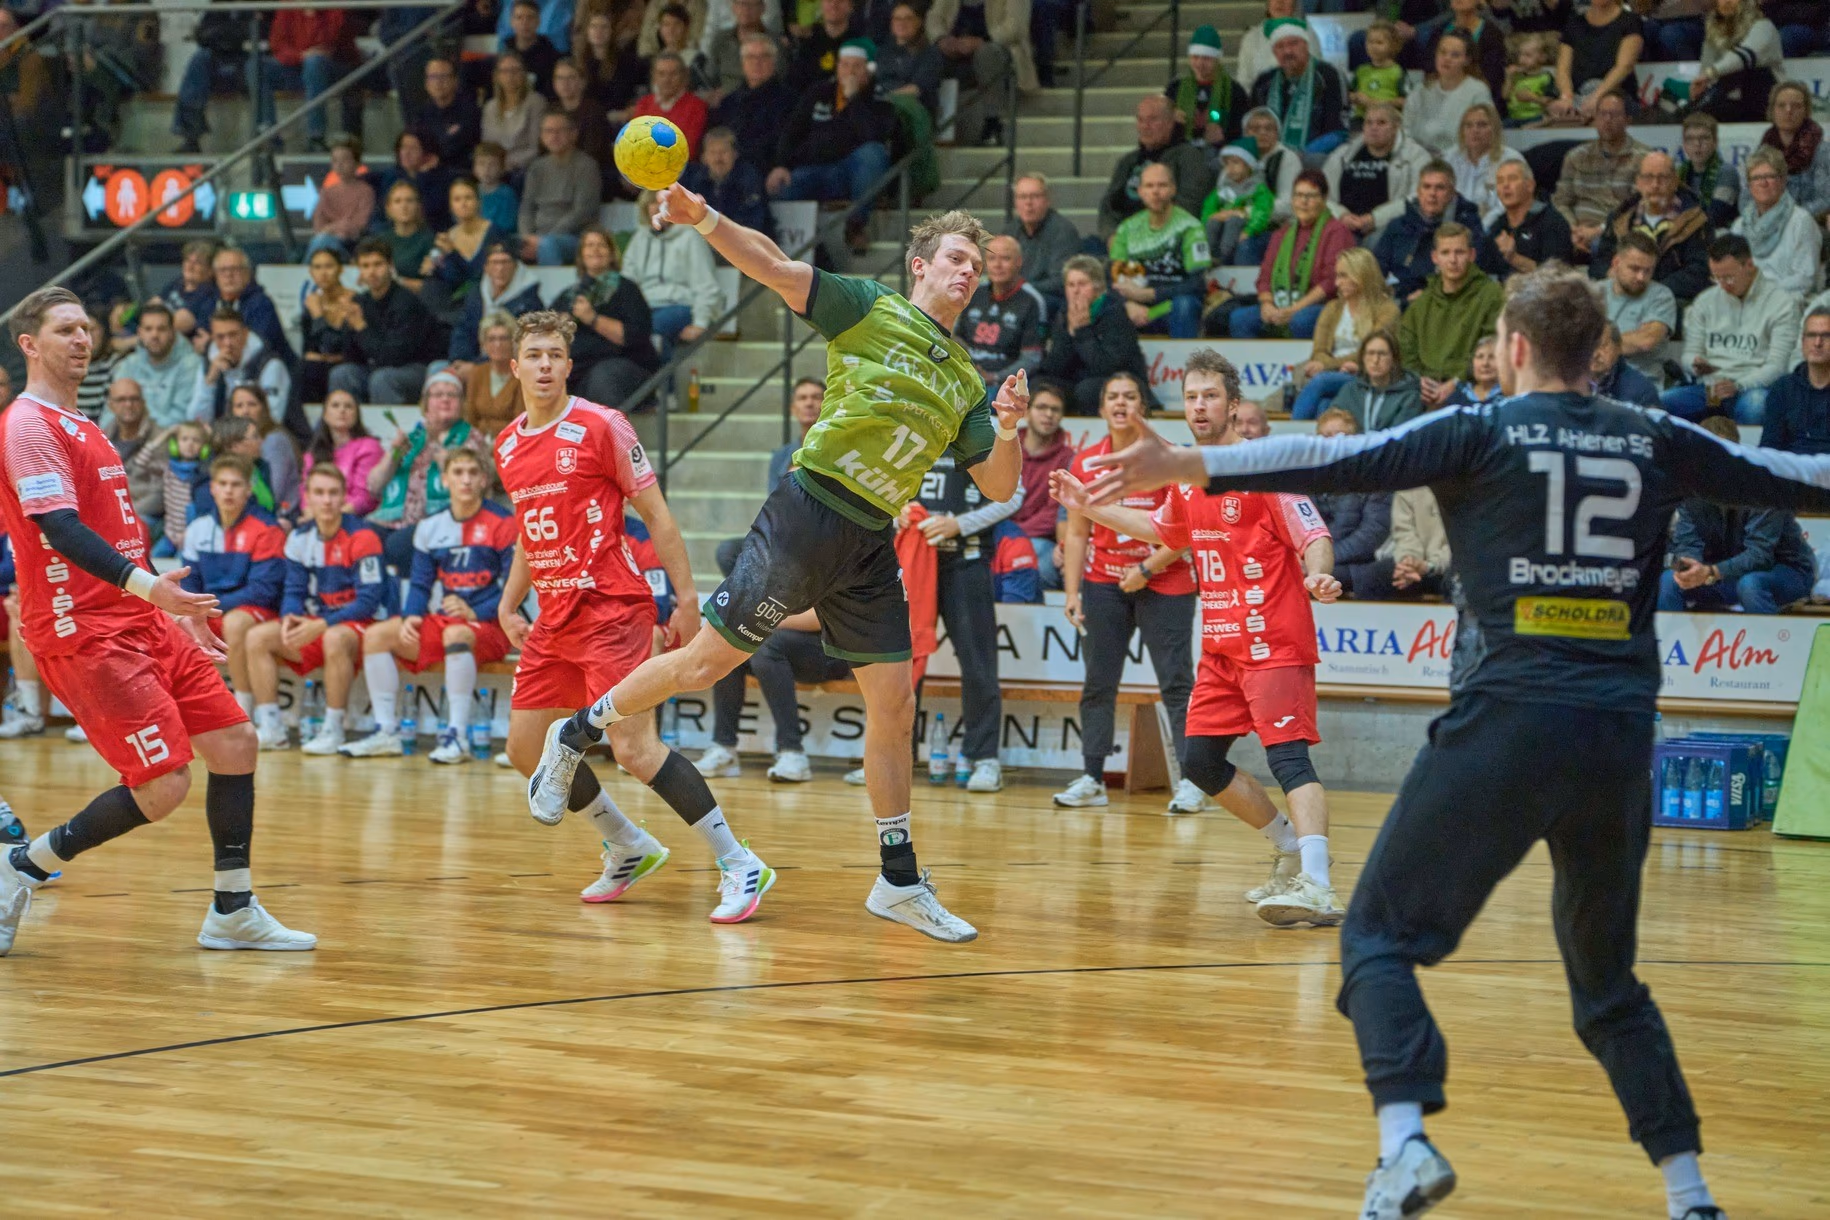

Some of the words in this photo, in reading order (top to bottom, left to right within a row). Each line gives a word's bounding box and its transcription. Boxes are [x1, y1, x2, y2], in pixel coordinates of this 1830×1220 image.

[882, 424, 928, 470] 17
[1506, 424, 1551, 446] HLZ
[920, 472, 946, 499] 21
[1528, 450, 1642, 560] 12
[524, 506, 559, 542] 66
[450, 547, 470, 567] 77
[1197, 550, 1226, 583] 18
[1509, 557, 1640, 593] Brockmeyer
[755, 600, 784, 626] gbg
[738, 623, 764, 642] Kempa
[1317, 626, 1404, 656] ARIA
[1693, 628, 1780, 674] Alm
[1710, 676, 1771, 689] Restaurant
[125, 724, 170, 768] 15
